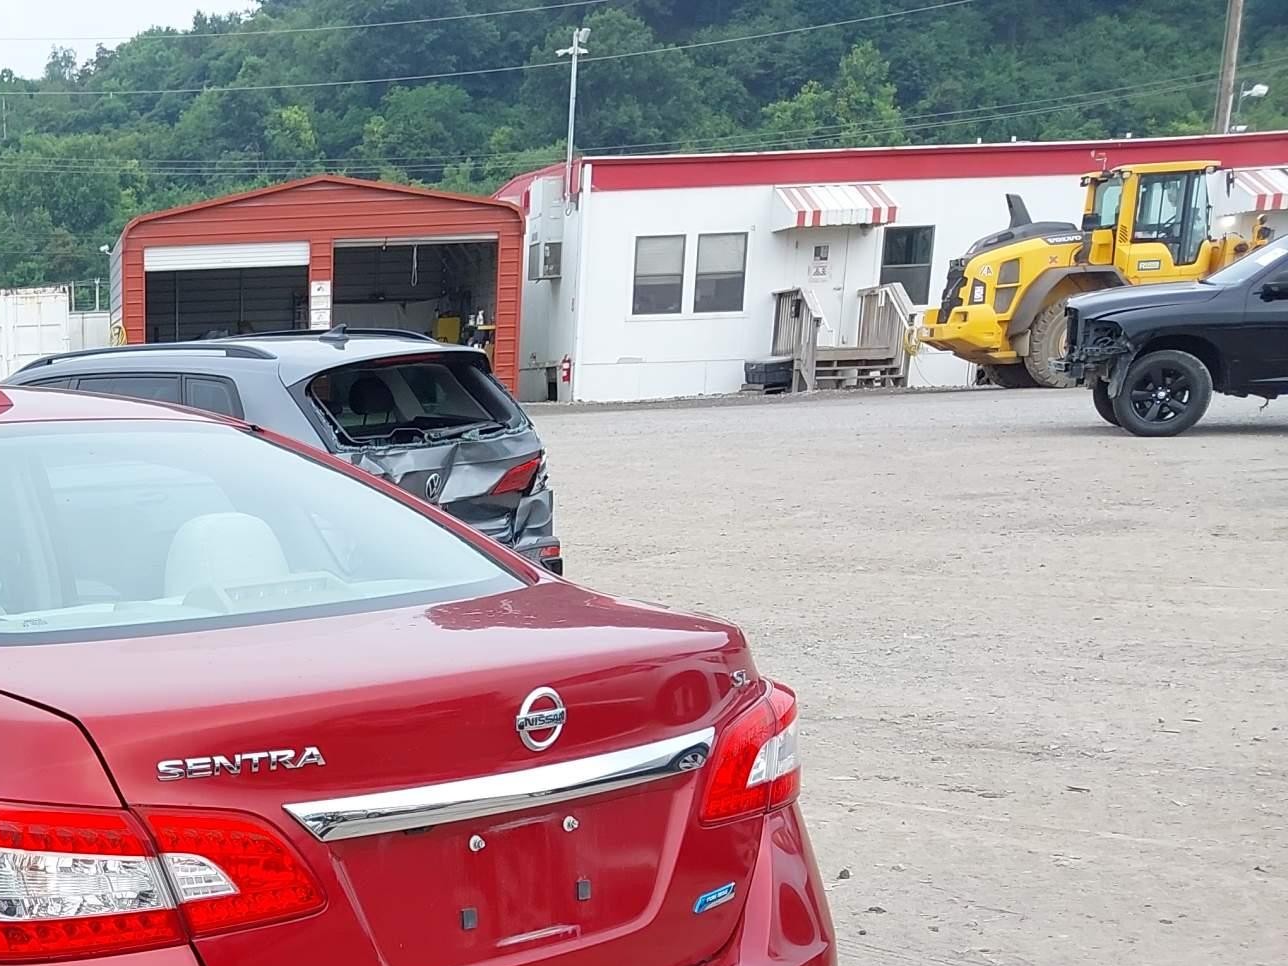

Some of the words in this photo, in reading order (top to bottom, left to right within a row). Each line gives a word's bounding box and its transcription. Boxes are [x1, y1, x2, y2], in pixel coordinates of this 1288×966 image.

[1047, 234, 1082, 243] VOLVO
[524, 709, 565, 727] NISSAN
[157, 746, 326, 781] SENTRA
